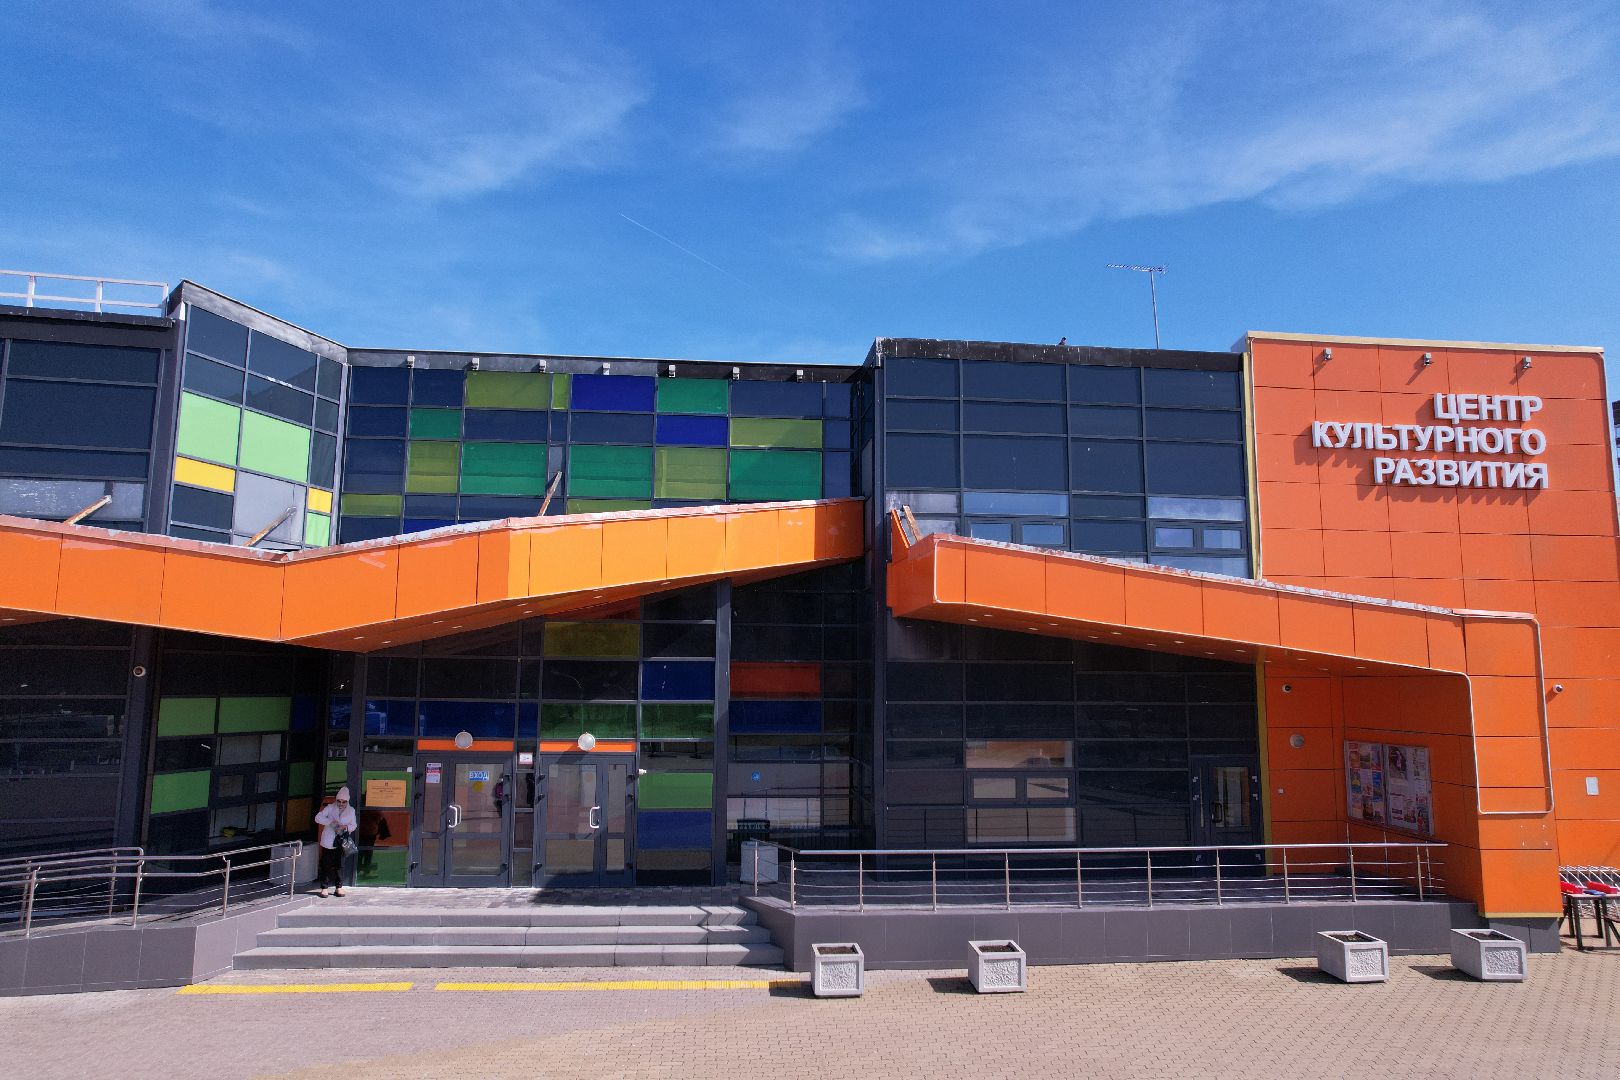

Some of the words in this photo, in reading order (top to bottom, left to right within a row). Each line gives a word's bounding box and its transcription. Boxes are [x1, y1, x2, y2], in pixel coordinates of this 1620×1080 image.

[1434, 393, 1543, 424] ЦЕНТР
[1311, 421, 1547, 456] КУЛЬТУРНОГО
[1373, 456, 1549, 489] РАЗВИТИЯ
